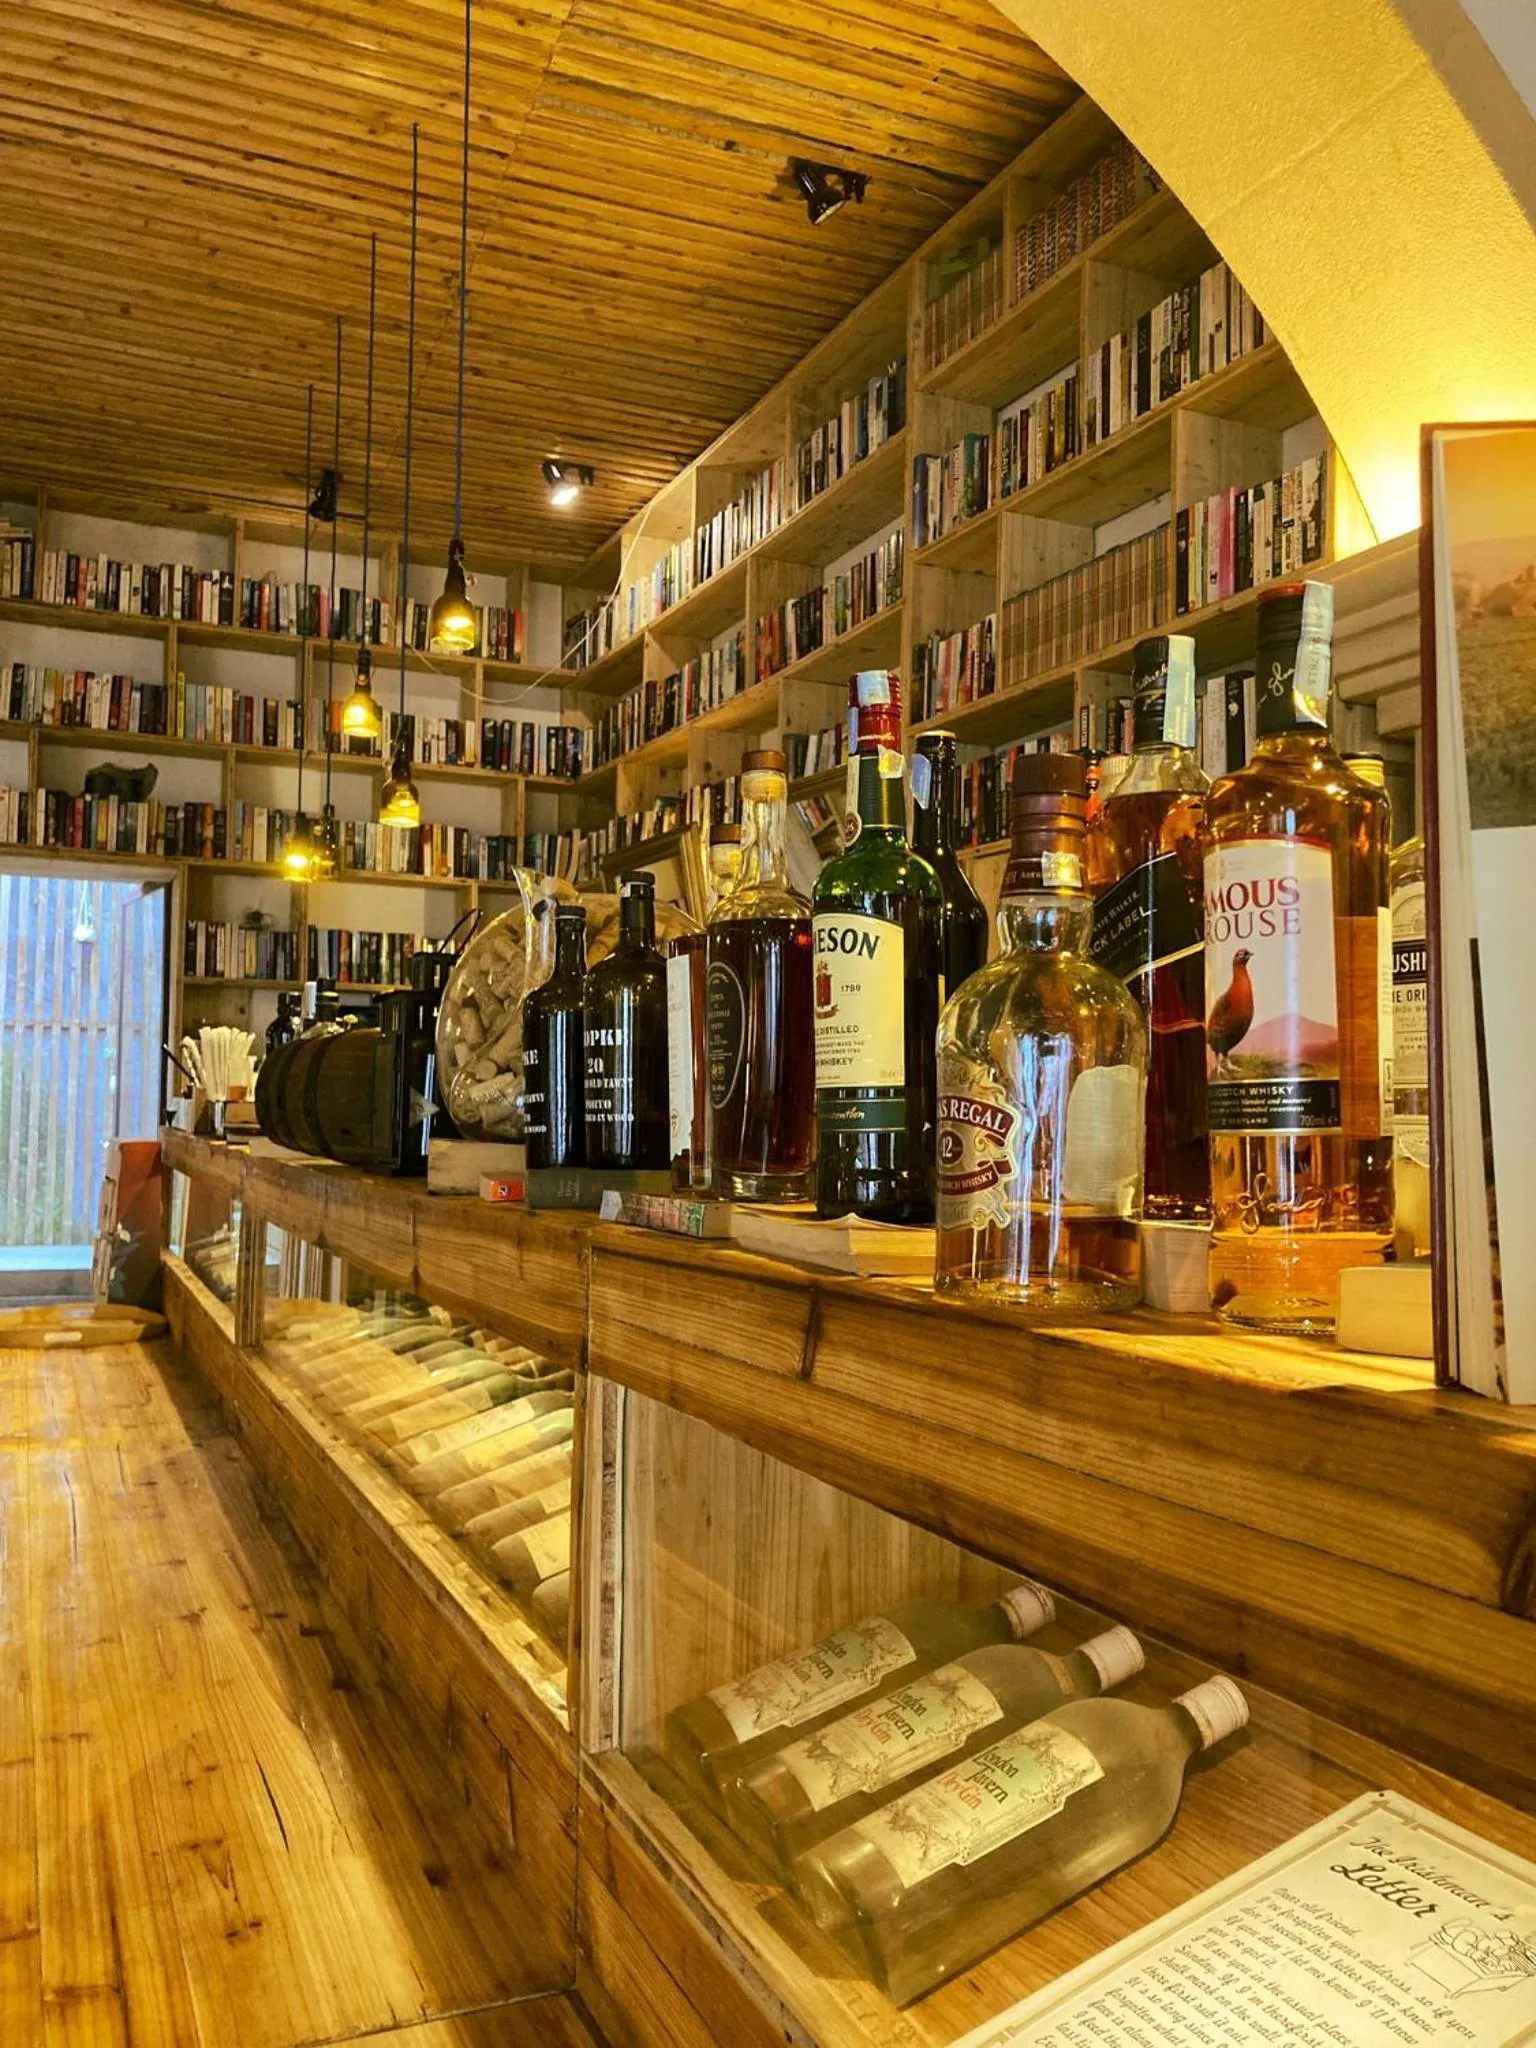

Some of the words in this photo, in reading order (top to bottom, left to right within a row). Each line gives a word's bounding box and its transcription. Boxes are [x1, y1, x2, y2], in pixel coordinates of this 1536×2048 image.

[587, 1057, 604, 1074] 20
[1249, 1086, 1294, 1096] WHISKY
[950, 1098, 1006, 1133] REGAL
[942, 1136, 953, 1158] 12
[886, 1685, 927, 1717] London
[870, 1720, 892, 1746] Gin
[876, 1703, 915, 1741] Tavern
[971, 1745, 1019, 1778] London
[938, 1771, 961, 1793] Dry
[959, 1784, 983, 1811] Gin
[963, 1765, 1008, 1806] Tavern
[1330, 1862, 1438, 1919] Letter
[1276, 1908, 1332, 1941] forgotten
[1328, 1940, 1361, 1960] your
[1305, 1943, 1331, 1961] this
[1329, 1958, 1362, 1982] letter
[1184, 1973, 1220, 1996] mark
[1104, 1987, 1156, 2024] forgotten
[1152, 2023, 1186, 2045] what
[1159, 2000, 1187, 2024] long
[1183, 2022, 1215, 2045] since
[1281, 1996, 1324, 2022] usual
[1312, 2020, 1352, 2045] place
[1380, 2017, 1419, 2044] know
